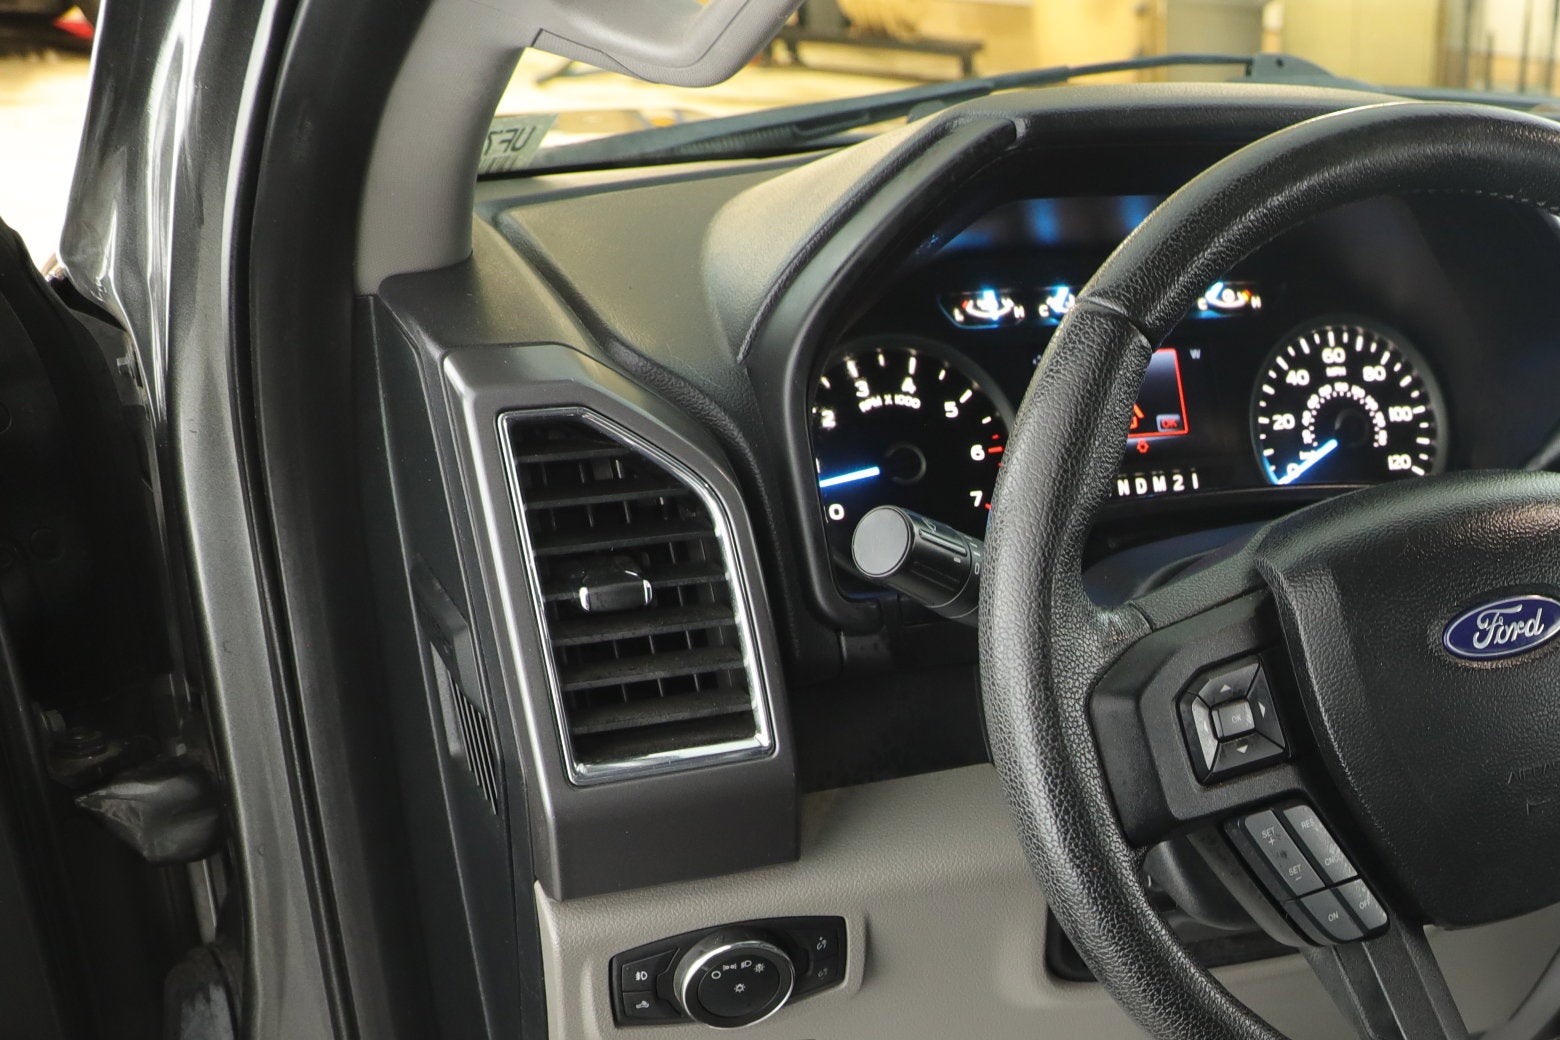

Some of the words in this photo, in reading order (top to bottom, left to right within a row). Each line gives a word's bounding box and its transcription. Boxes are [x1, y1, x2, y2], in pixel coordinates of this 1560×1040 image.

[1321, 347, 1346, 364] 60
[1285, 369, 1310, 386] 40
[1362, 365, 1386, 382] 80
[854, 380, 870, 398] 3
[901, 377, 917, 394] 4
[944, 401, 959, 418] 5
[1388, 406, 1413, 422] 100
[821, 409, 836, 429] 2
[1272, 413, 1295, 430] 20
[970, 444, 986, 461] 6
[1388, 454, 1412, 471] 120
[1134, 477, 1148, 495] D
[1152, 475, 1167, 492] M
[1172, 474, 1185, 491] 2
[970, 490, 983, 507] 7
[828, 503, 845, 520] 0
[1472, 604, 1545, 649] Ford
[1262, 826, 1275, 839] SET
[1288, 864, 1301, 876] SET
[1328, 911, 1339, 922] ON
